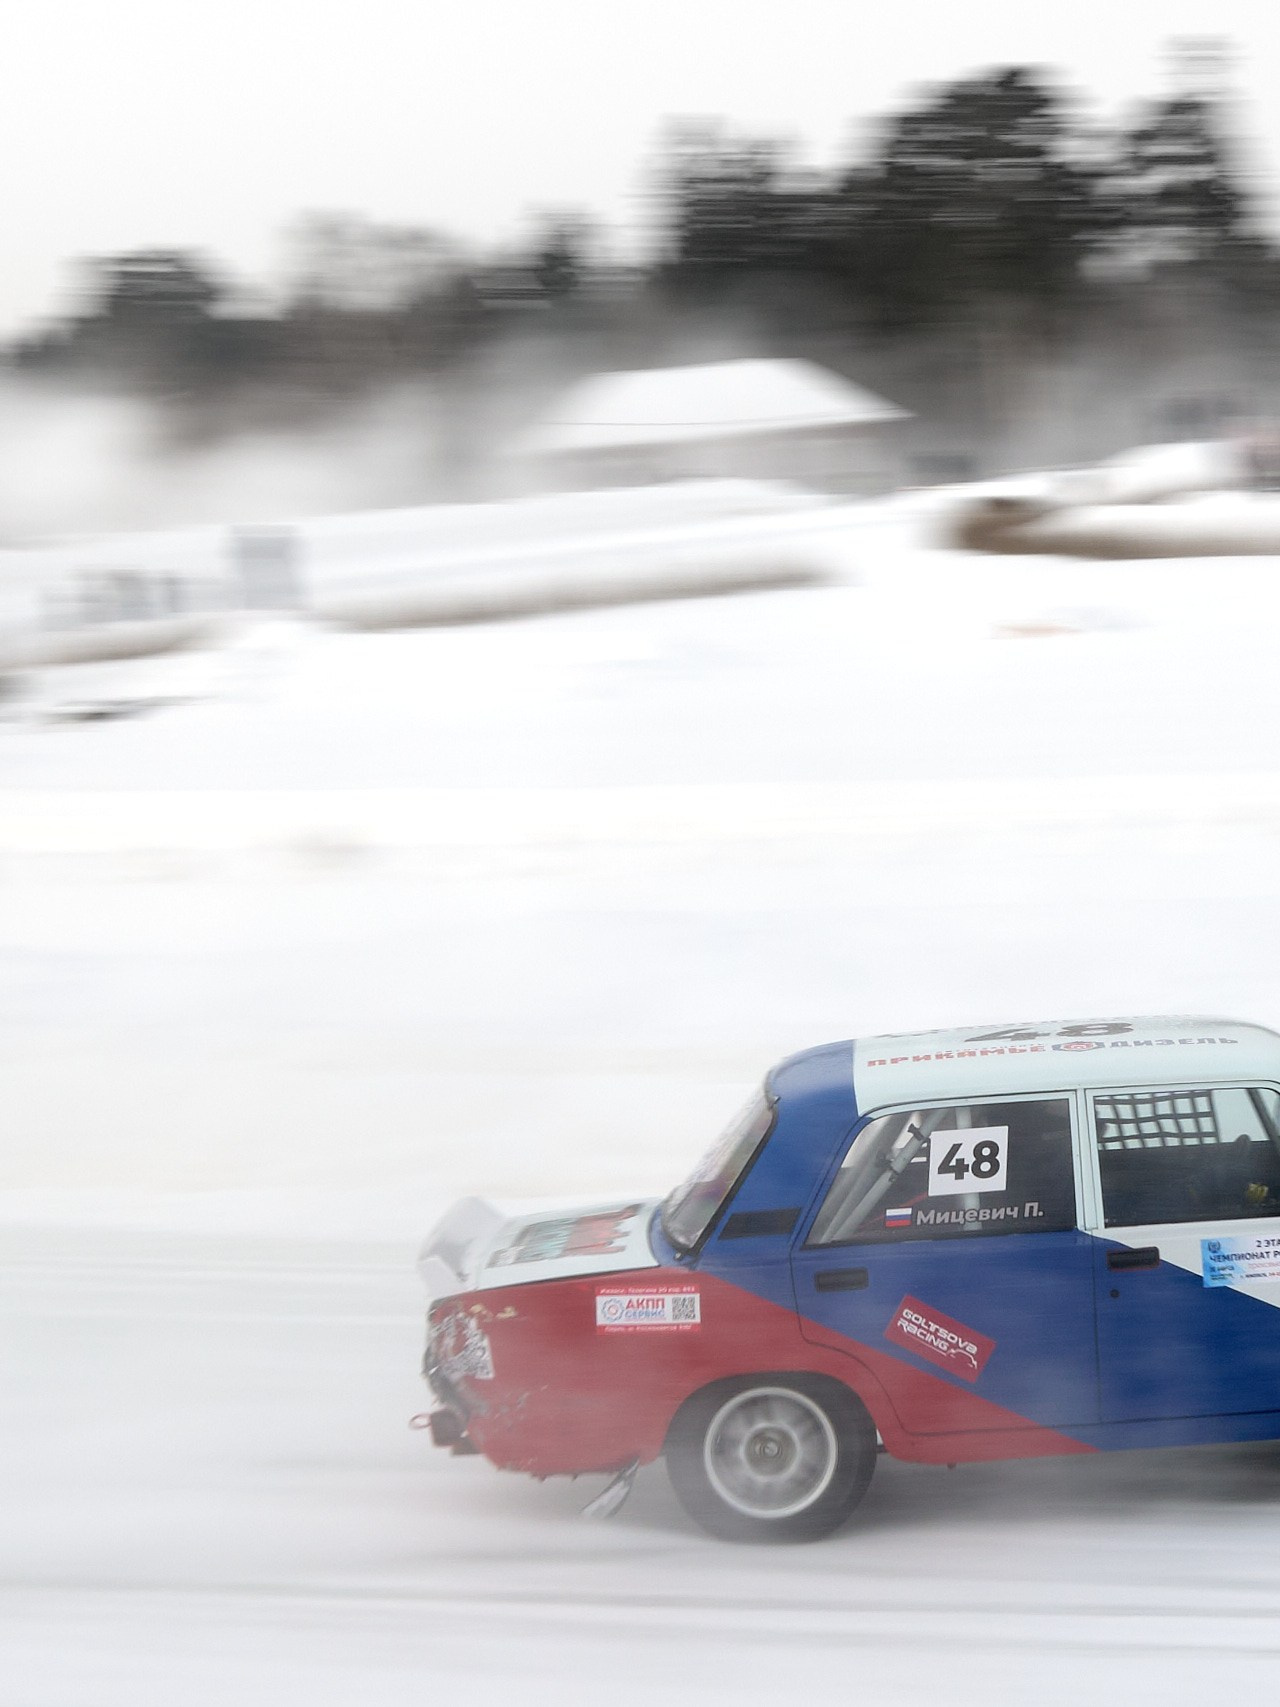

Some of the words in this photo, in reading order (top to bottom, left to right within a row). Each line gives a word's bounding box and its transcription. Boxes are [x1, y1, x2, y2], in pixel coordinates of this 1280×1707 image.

[964, 1022, 1134, 1042] 48
[867, 1045, 1046, 1067] ПРИКАМЬЕ
[1110, 1037, 1239, 1048] ДИЗЕЛЬ
[937, 1140, 1001, 1181] 48
[916, 1206, 1019, 1225] Мицевич
[1023, 1202, 1044, 1219] П.
[1256, 1240, 1262, 1248] 2
[1209, 1251, 1270, 1262] ЧЕМПИОНАТ
[626, 1298, 665, 1310] АКПП
[624, 1309, 665, 1319] СЕРВИС
